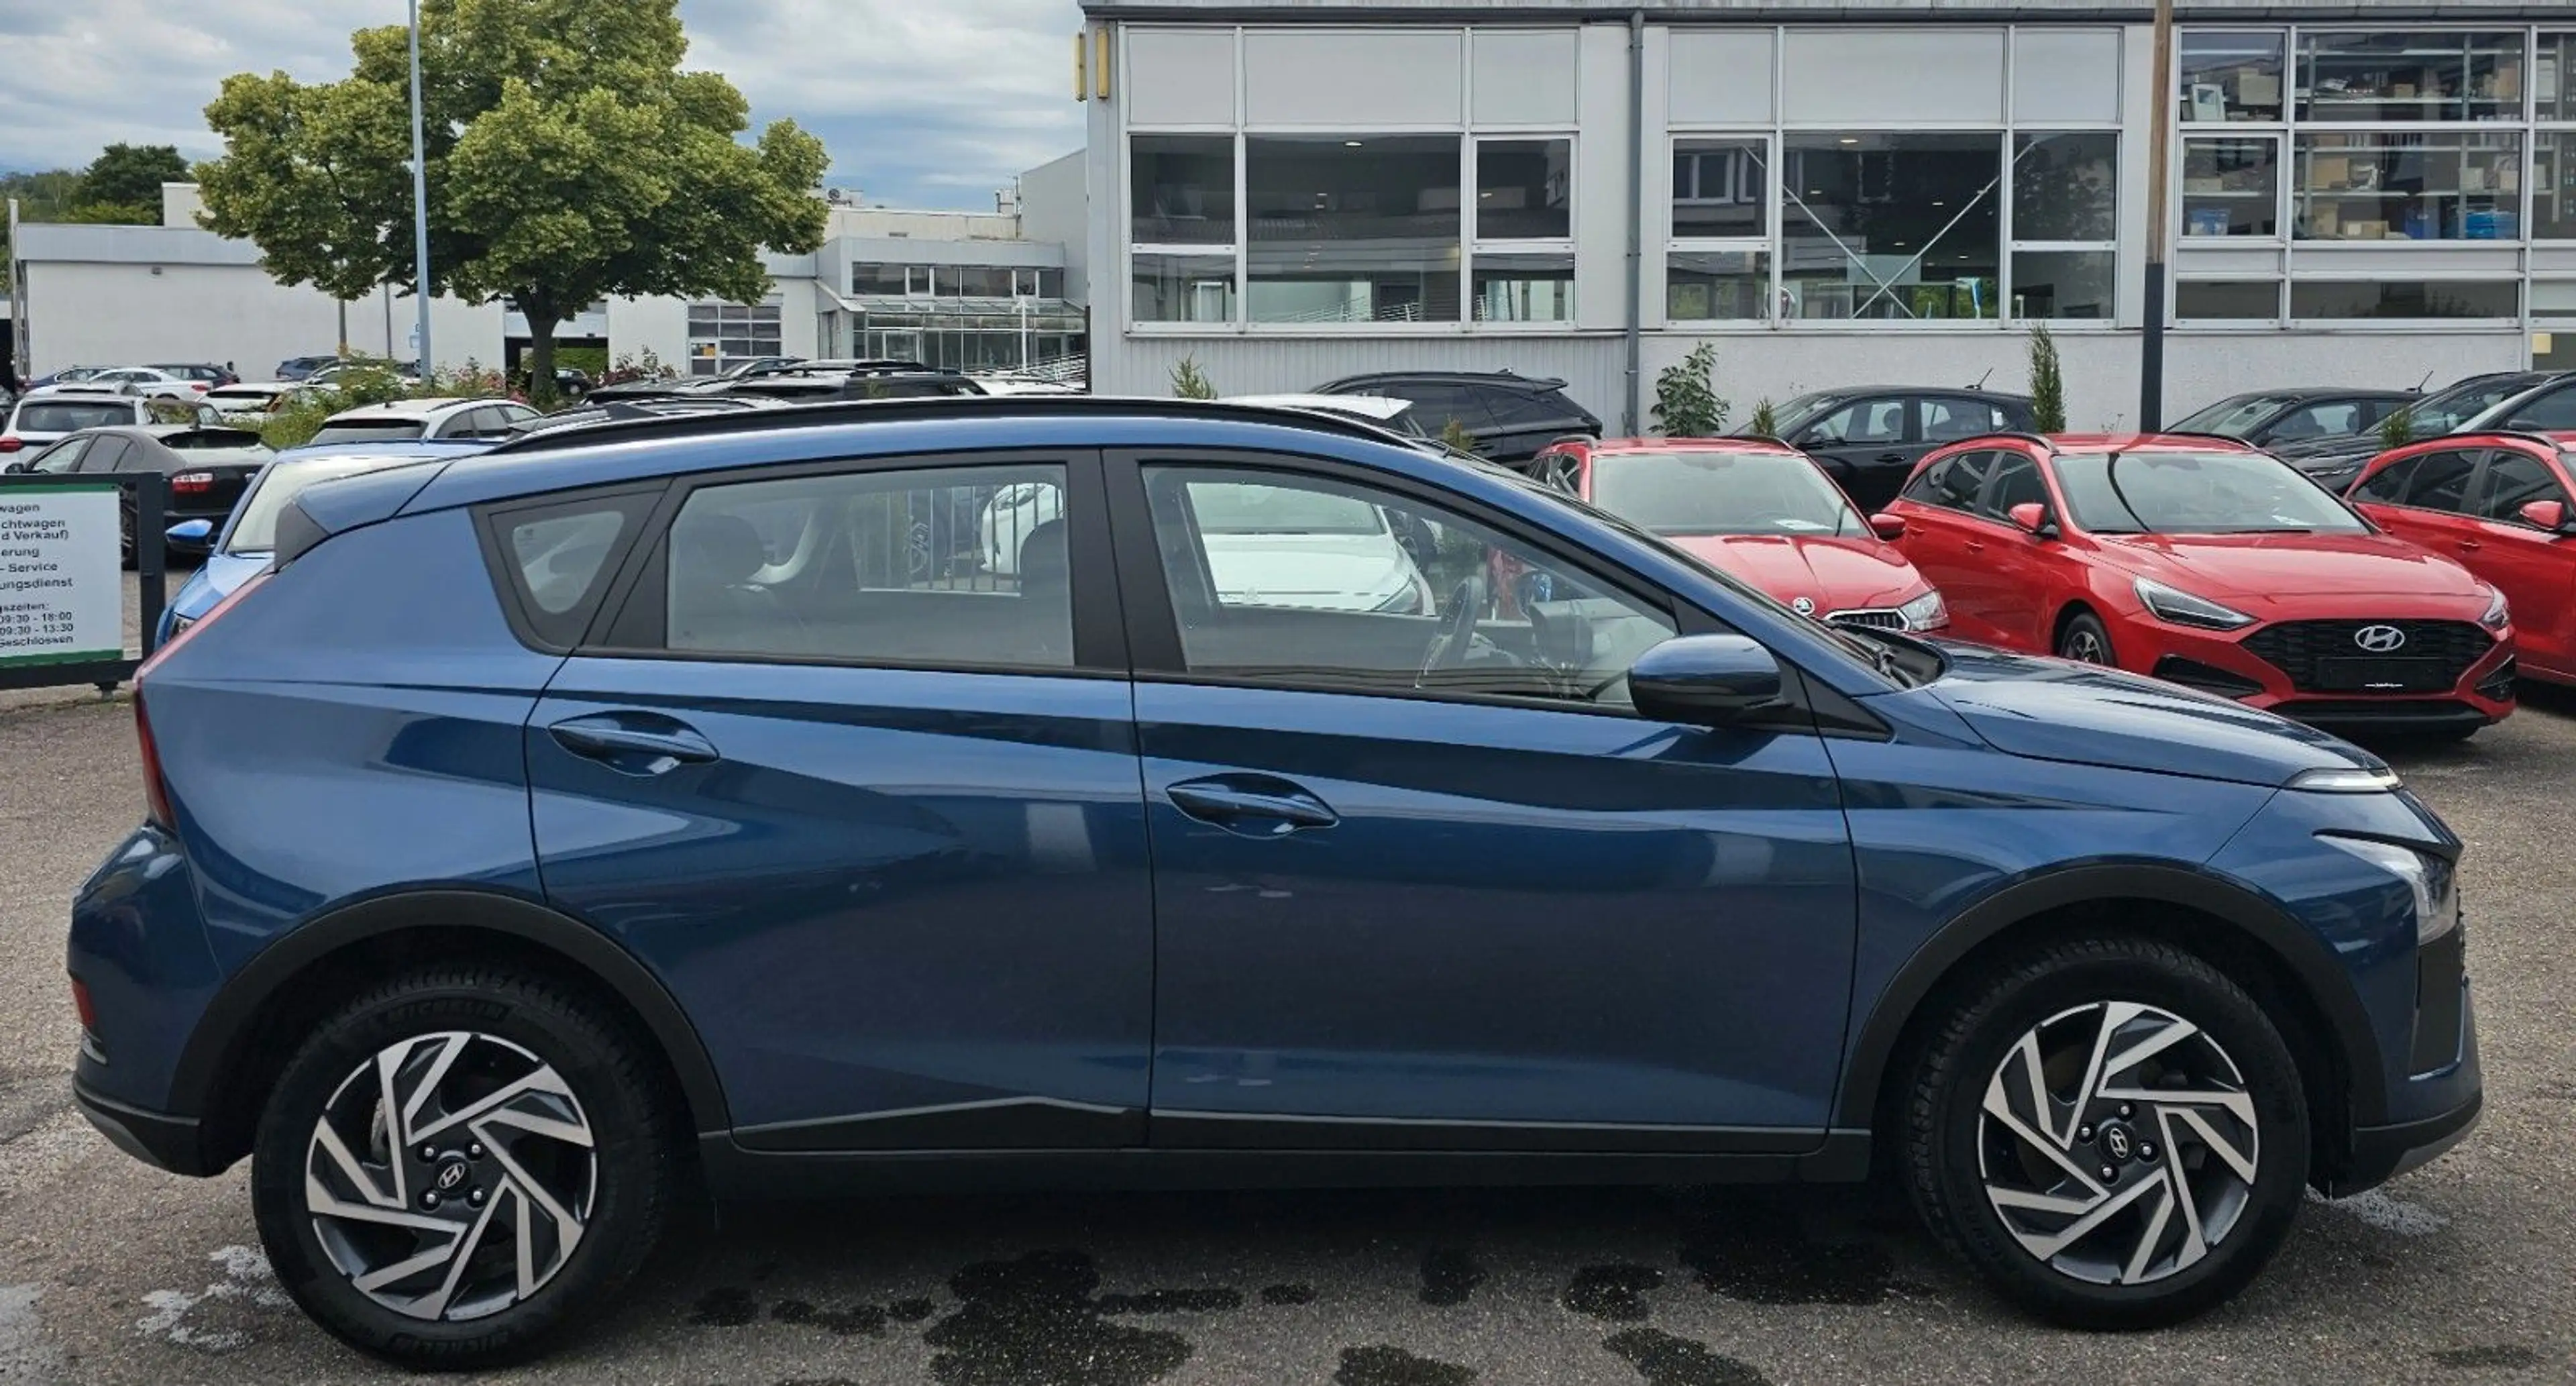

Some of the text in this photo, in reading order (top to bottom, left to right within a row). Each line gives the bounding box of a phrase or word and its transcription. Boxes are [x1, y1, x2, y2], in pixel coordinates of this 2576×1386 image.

[1, 547, 40, 558] erung
[8, 562, 58, 573] Service
[42, 611, 72, 622] 18:00
